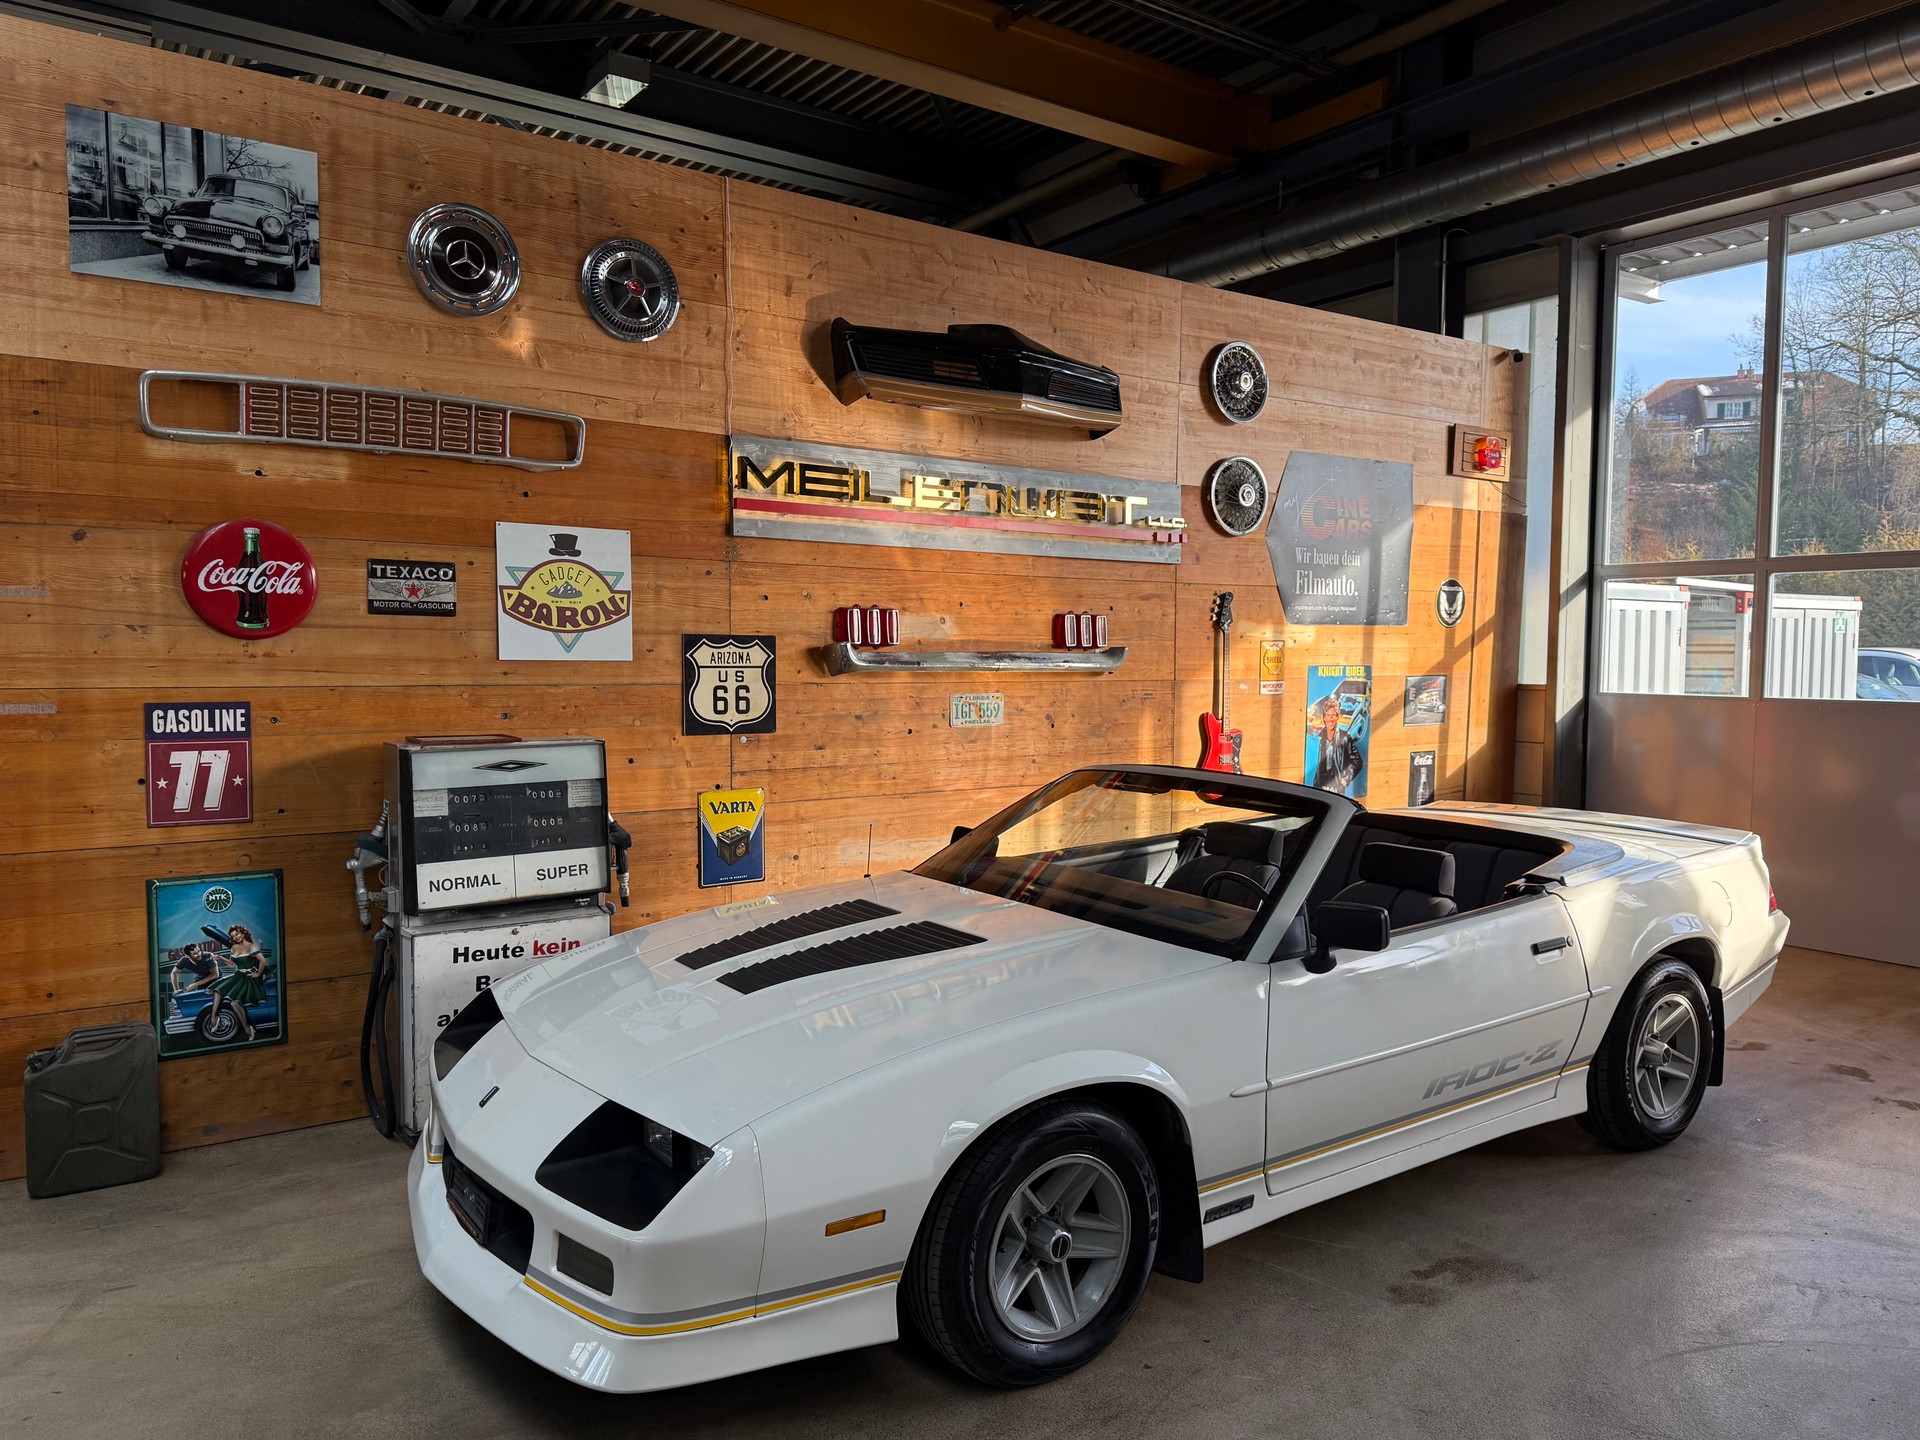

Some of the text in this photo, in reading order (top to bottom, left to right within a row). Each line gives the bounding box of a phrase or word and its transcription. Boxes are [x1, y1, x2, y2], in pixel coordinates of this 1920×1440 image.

[1295, 546, 1361, 566] Wir bauen dein
[197, 558, 305, 595] Coca-Cola
[372, 564, 453, 581] TEXACO
[538, 566, 594, 587] GADGET
[1295, 569, 1359, 597] Filmauto.
[373, 600, 454, 610] MOTOR OIL GASOLINE
[507, 591, 626, 629] BARON
[710, 651, 752, 665] ARIZONA
[1266, 656, 1282, 664] SHELL
[1318, 665, 1344, 678] KNIGHT
[712, 684, 751, 716] 66
[978, 701, 1001, 720] 559
[151, 708, 247, 734] GASOLINE
[168, 749, 231, 813] 77
[708, 800, 757, 815] VARTA
[536, 863, 589, 882] SUPER
[428, 873, 502, 893] NORMAL
[207, 893, 228, 901] NTK
[452, 937, 581, 964] Heute kein
[1421, 1038, 1564, 1100] IROC-Z
